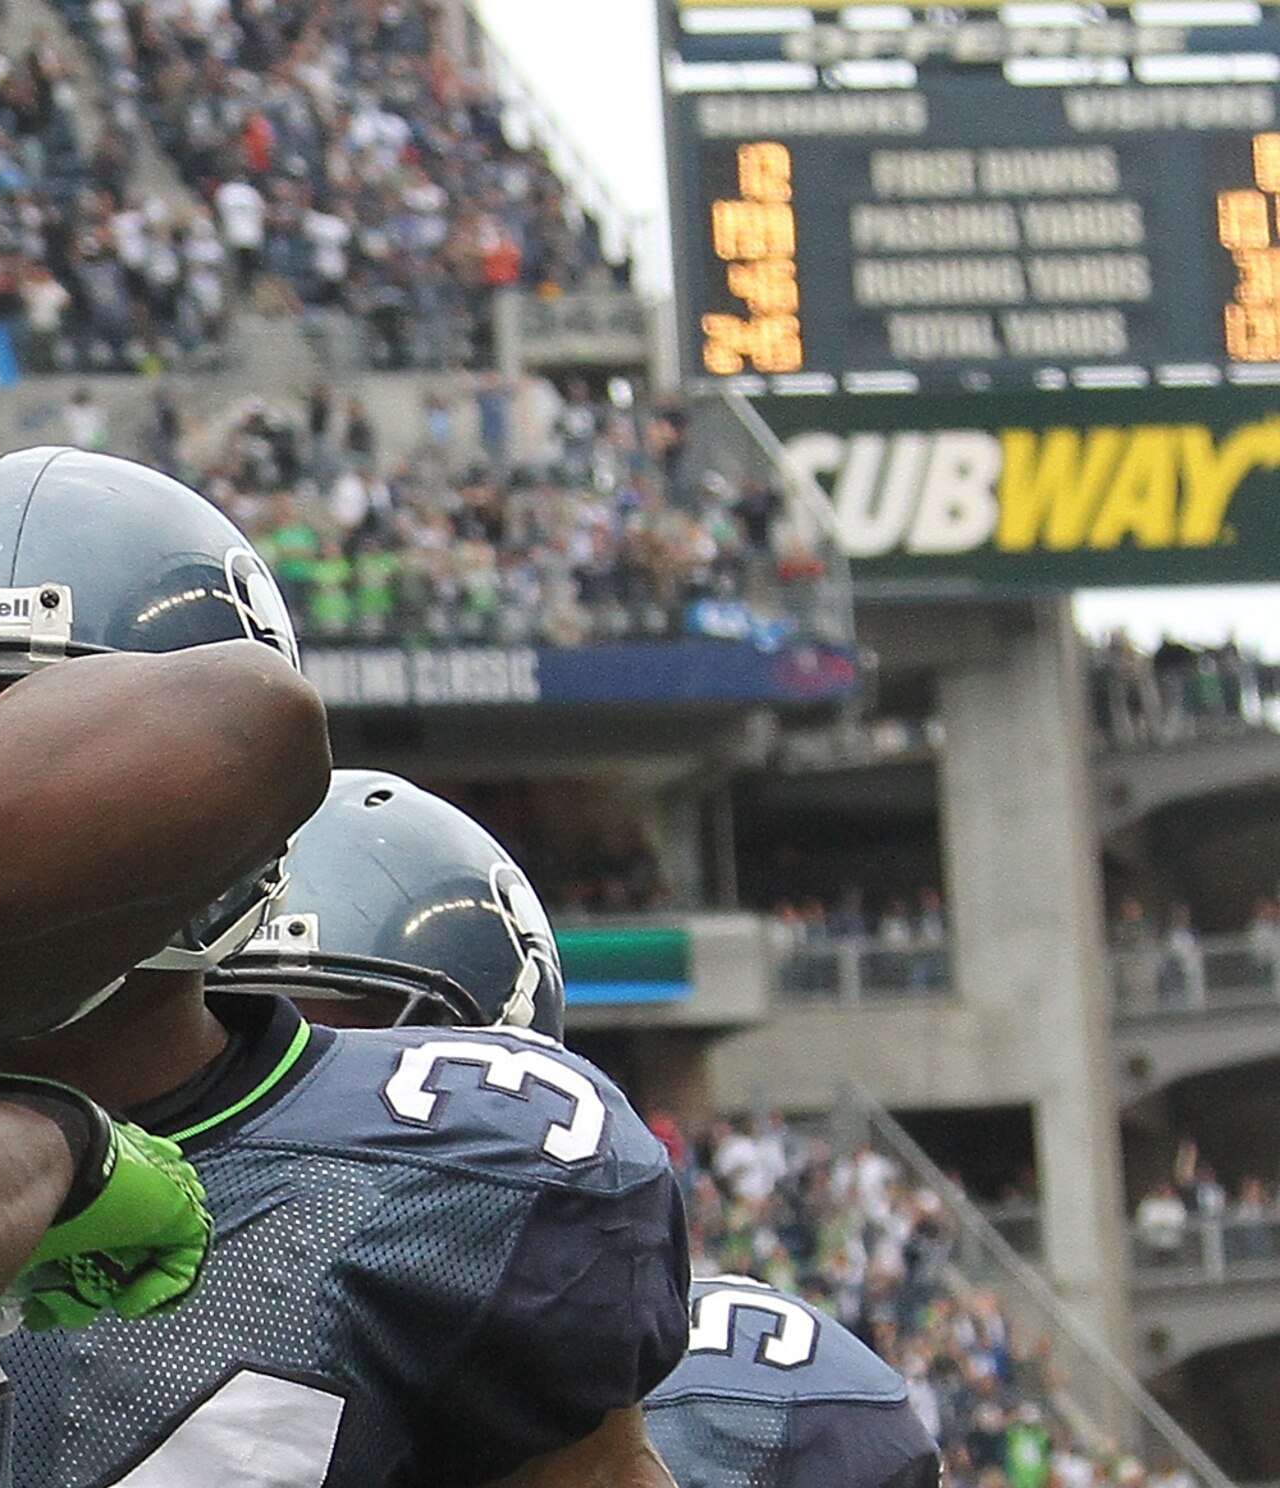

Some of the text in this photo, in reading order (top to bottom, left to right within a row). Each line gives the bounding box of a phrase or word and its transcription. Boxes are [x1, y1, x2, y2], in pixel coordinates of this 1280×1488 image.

[870, 146, 1120, 197] FIRST DOWNS
[850, 200, 1145, 252] PASSING YARDS
[852, 254, 1153, 307] RUSHING YARDS
[890, 306, 1130, 361] TOTAL YARDS
[772, 412, 1280, 556] SUBWAY
